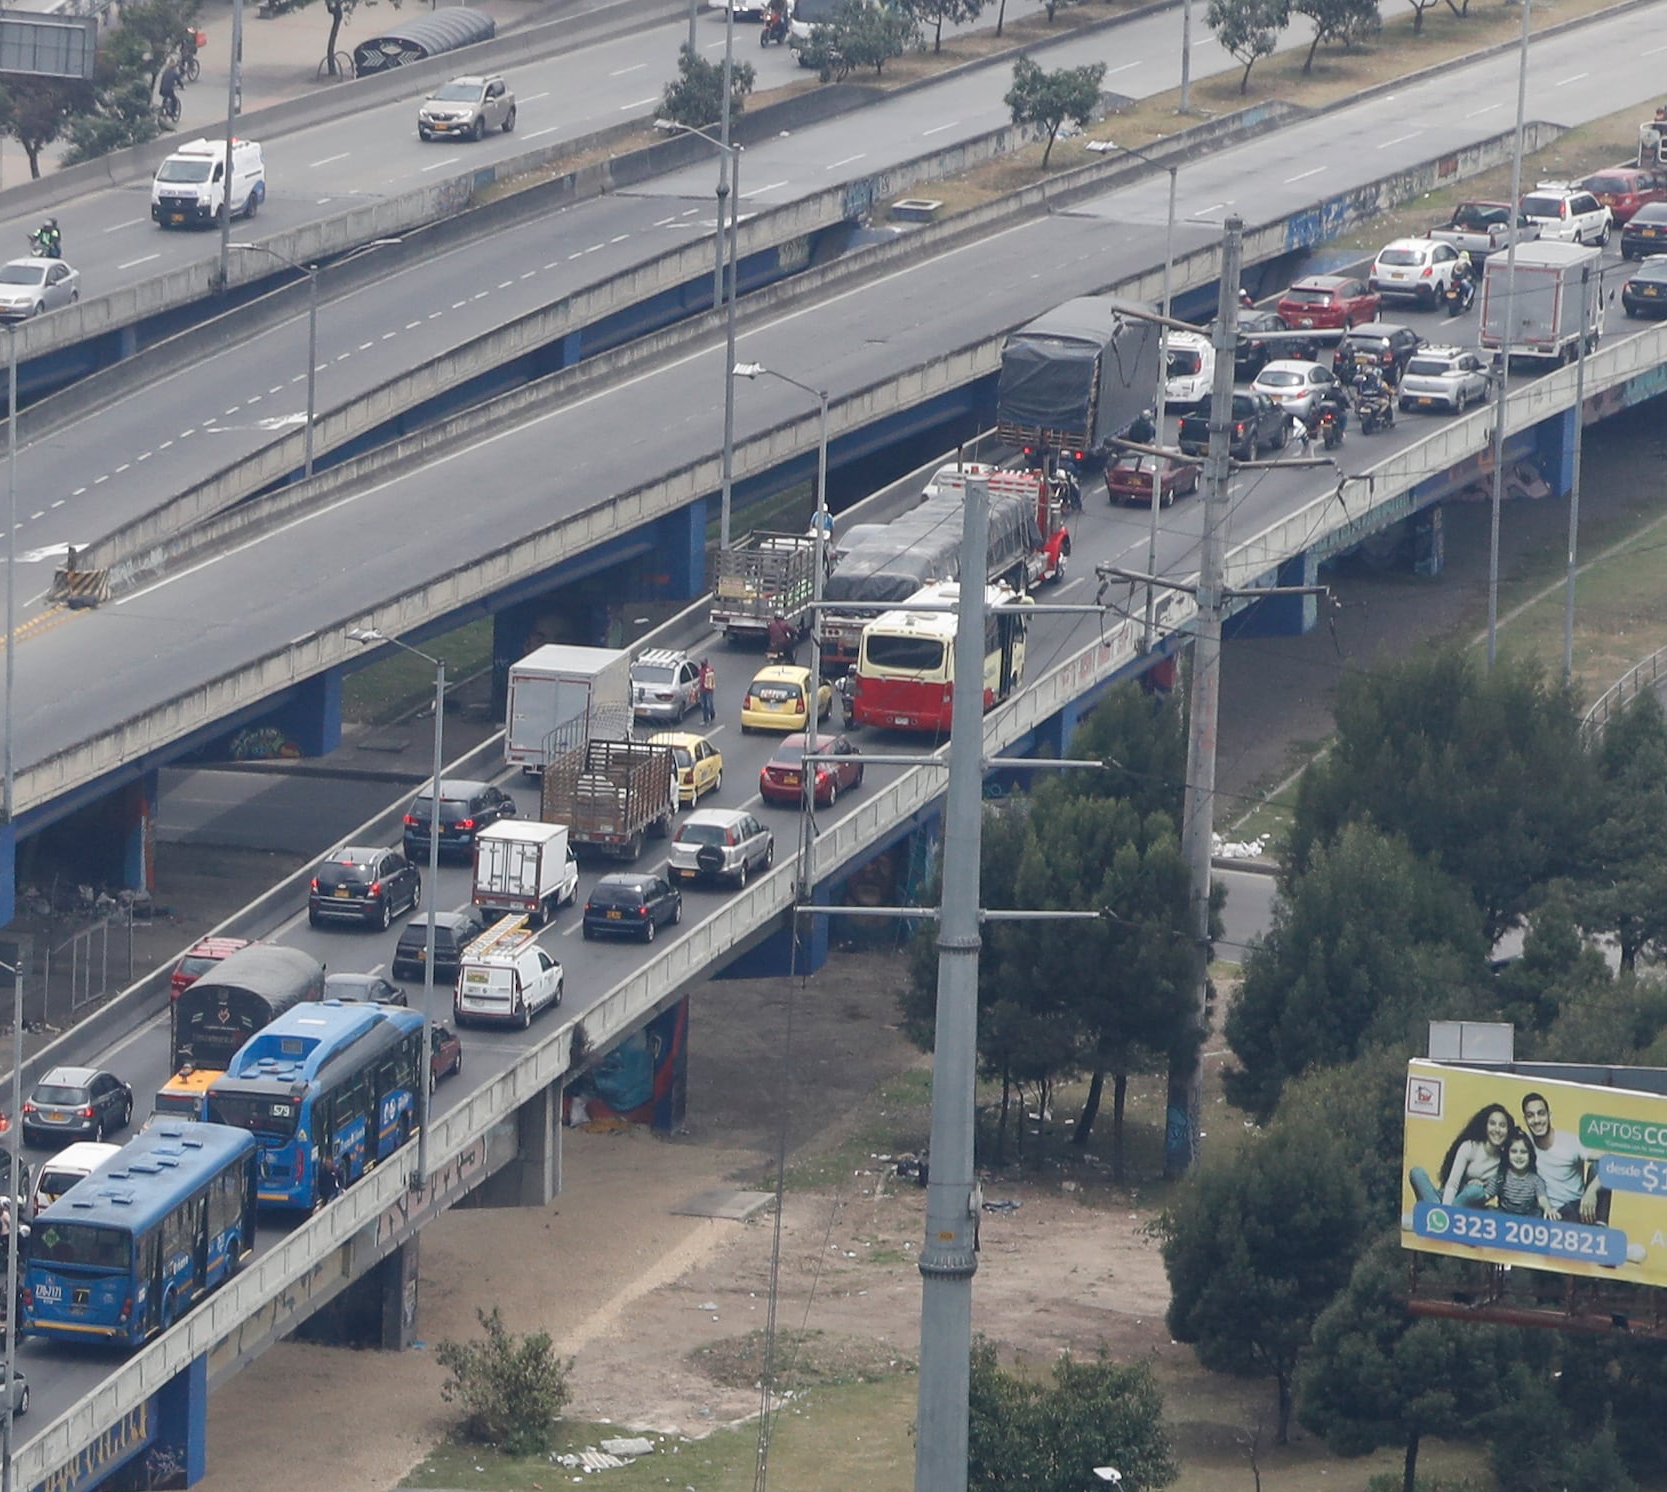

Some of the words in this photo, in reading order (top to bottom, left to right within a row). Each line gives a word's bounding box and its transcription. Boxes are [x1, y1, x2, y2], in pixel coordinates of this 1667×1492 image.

[273, 1104, 290, 1117] 579
[1587, 1119, 1642, 1141] APTOS
[1606, 1162, 1641, 1177] desde
[1453, 1214, 1497, 1241] 323
[1505, 1221, 1609, 1256] 2092821
